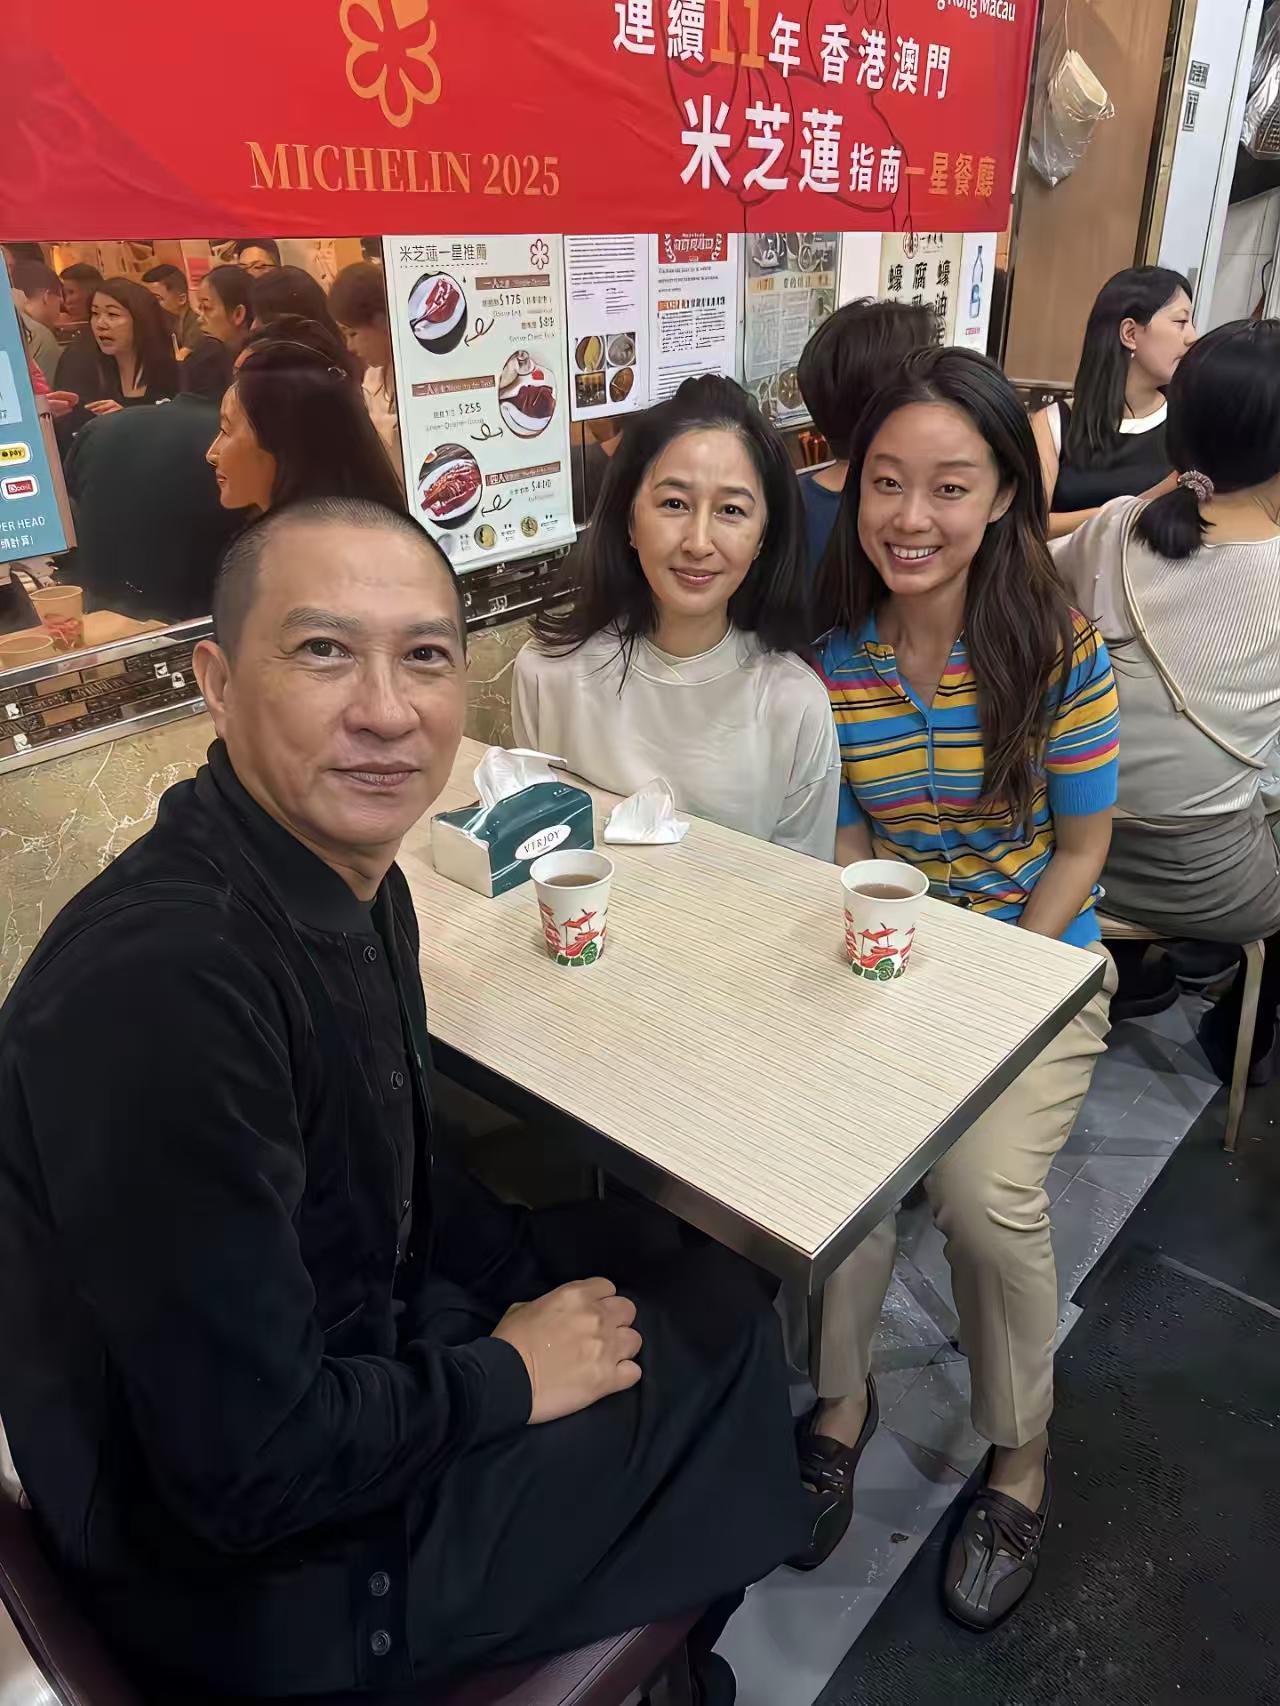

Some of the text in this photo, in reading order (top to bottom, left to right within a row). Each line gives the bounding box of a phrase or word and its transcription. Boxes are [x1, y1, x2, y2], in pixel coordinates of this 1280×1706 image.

[980, 0, 1016, 21] Macau
[820, 23, 950, 100] 香港澳門
[244, 141, 560, 196] MICHELIN 2025
[0, 516, 46, 532] ER HEAD
[523, 829, 561, 853] VIRJOY
